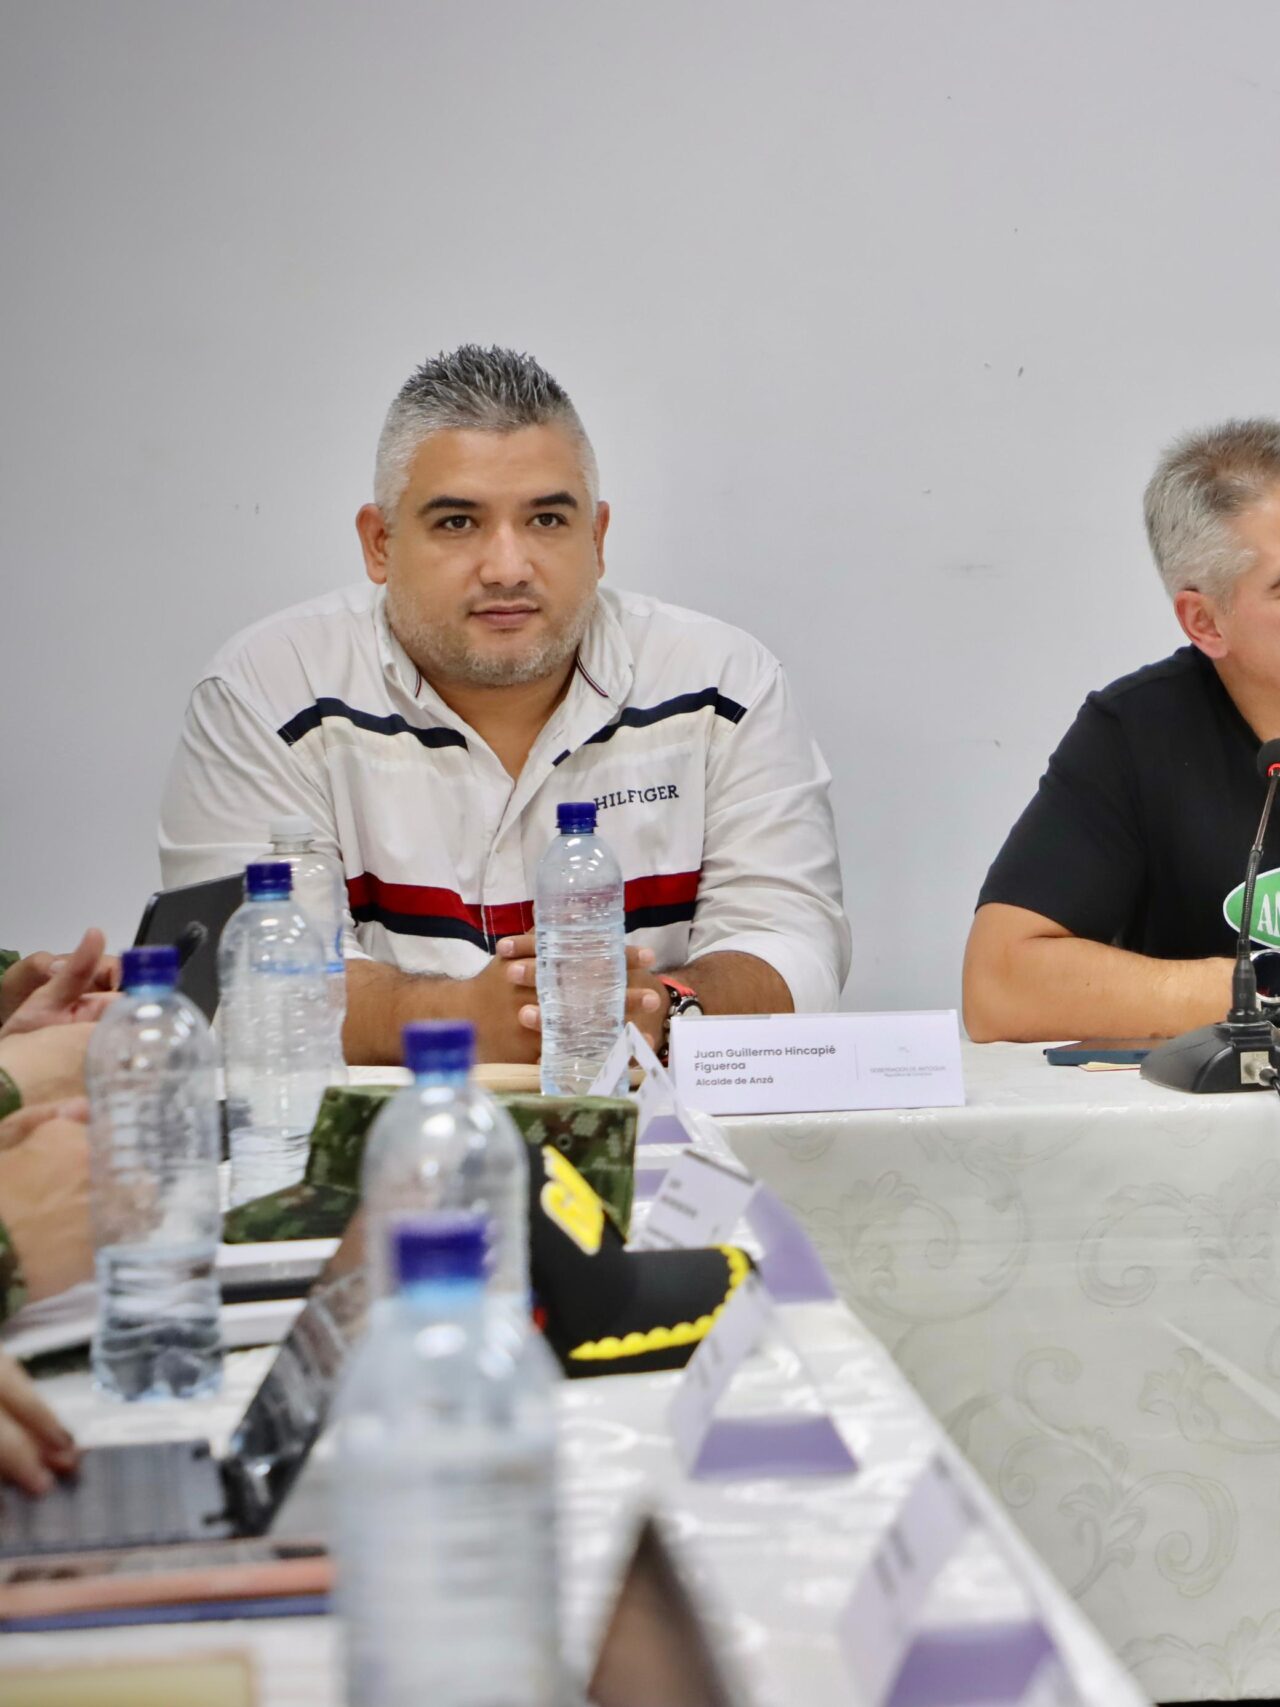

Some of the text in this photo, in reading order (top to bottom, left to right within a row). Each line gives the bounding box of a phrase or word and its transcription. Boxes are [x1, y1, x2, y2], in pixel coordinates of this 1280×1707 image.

[593, 784, 680, 811] HILFIGER
[693, 1045, 836, 1059] Juan Guillermo Hincapié
[694, 1061, 747, 1074] Figueroa
[695, 1075, 774, 1087] Alcalde de Anzá
